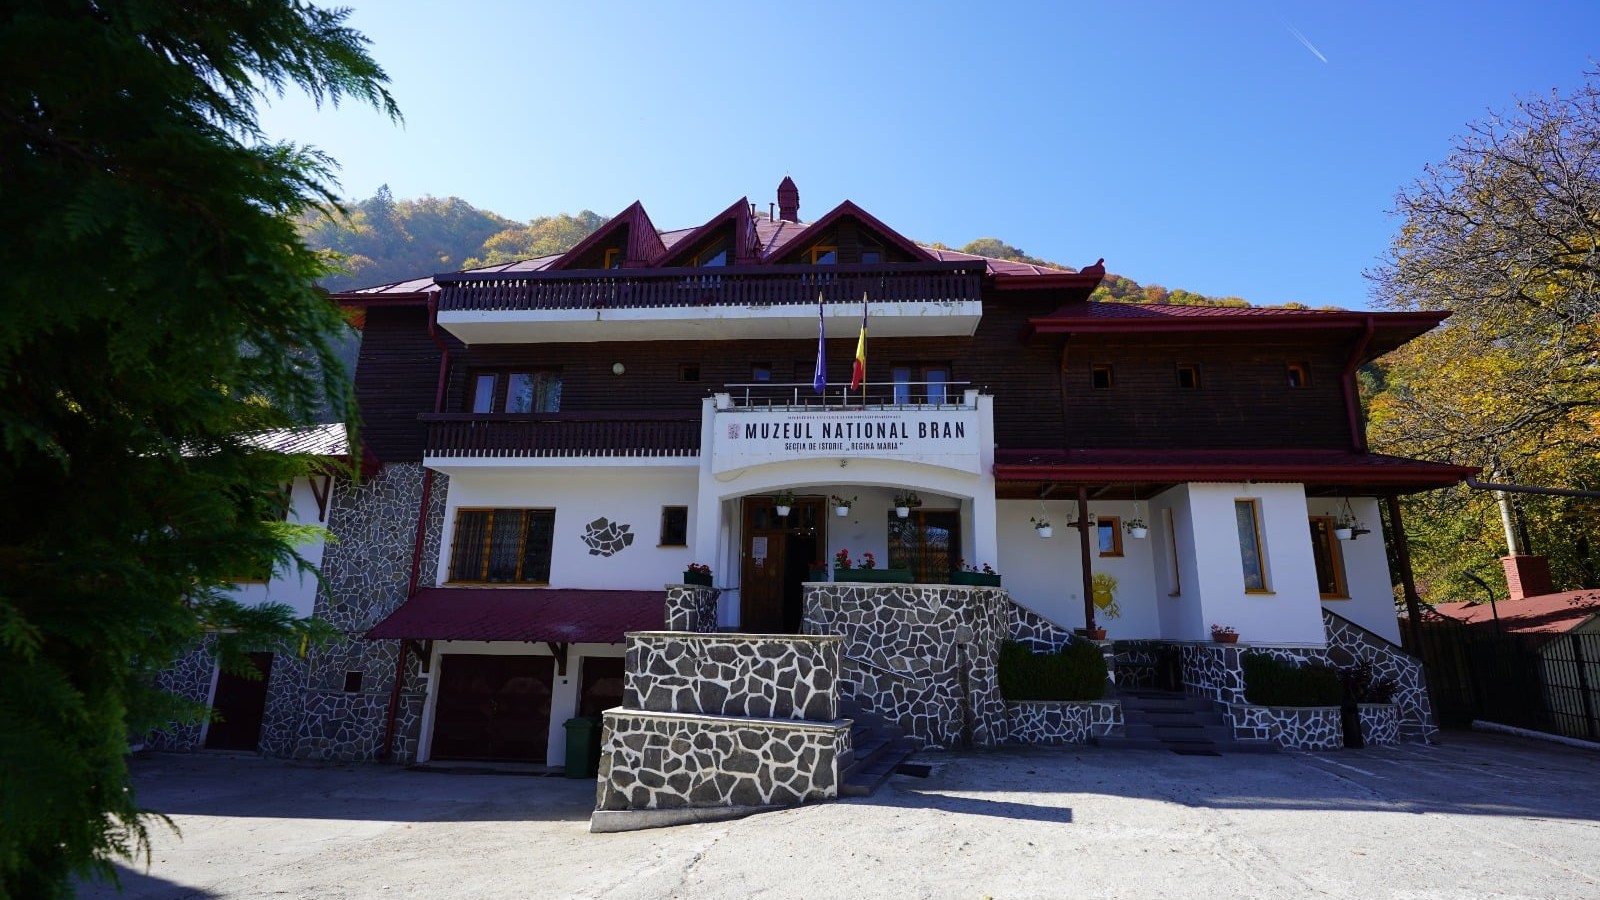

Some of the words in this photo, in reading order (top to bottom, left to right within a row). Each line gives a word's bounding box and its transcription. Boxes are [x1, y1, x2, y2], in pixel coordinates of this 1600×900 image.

[745, 422, 813, 439] MUZEUL
[918, 421, 965, 439] BRAN
[808, 442, 816, 451] DE
[818, 442, 843, 451] ISTORIE
